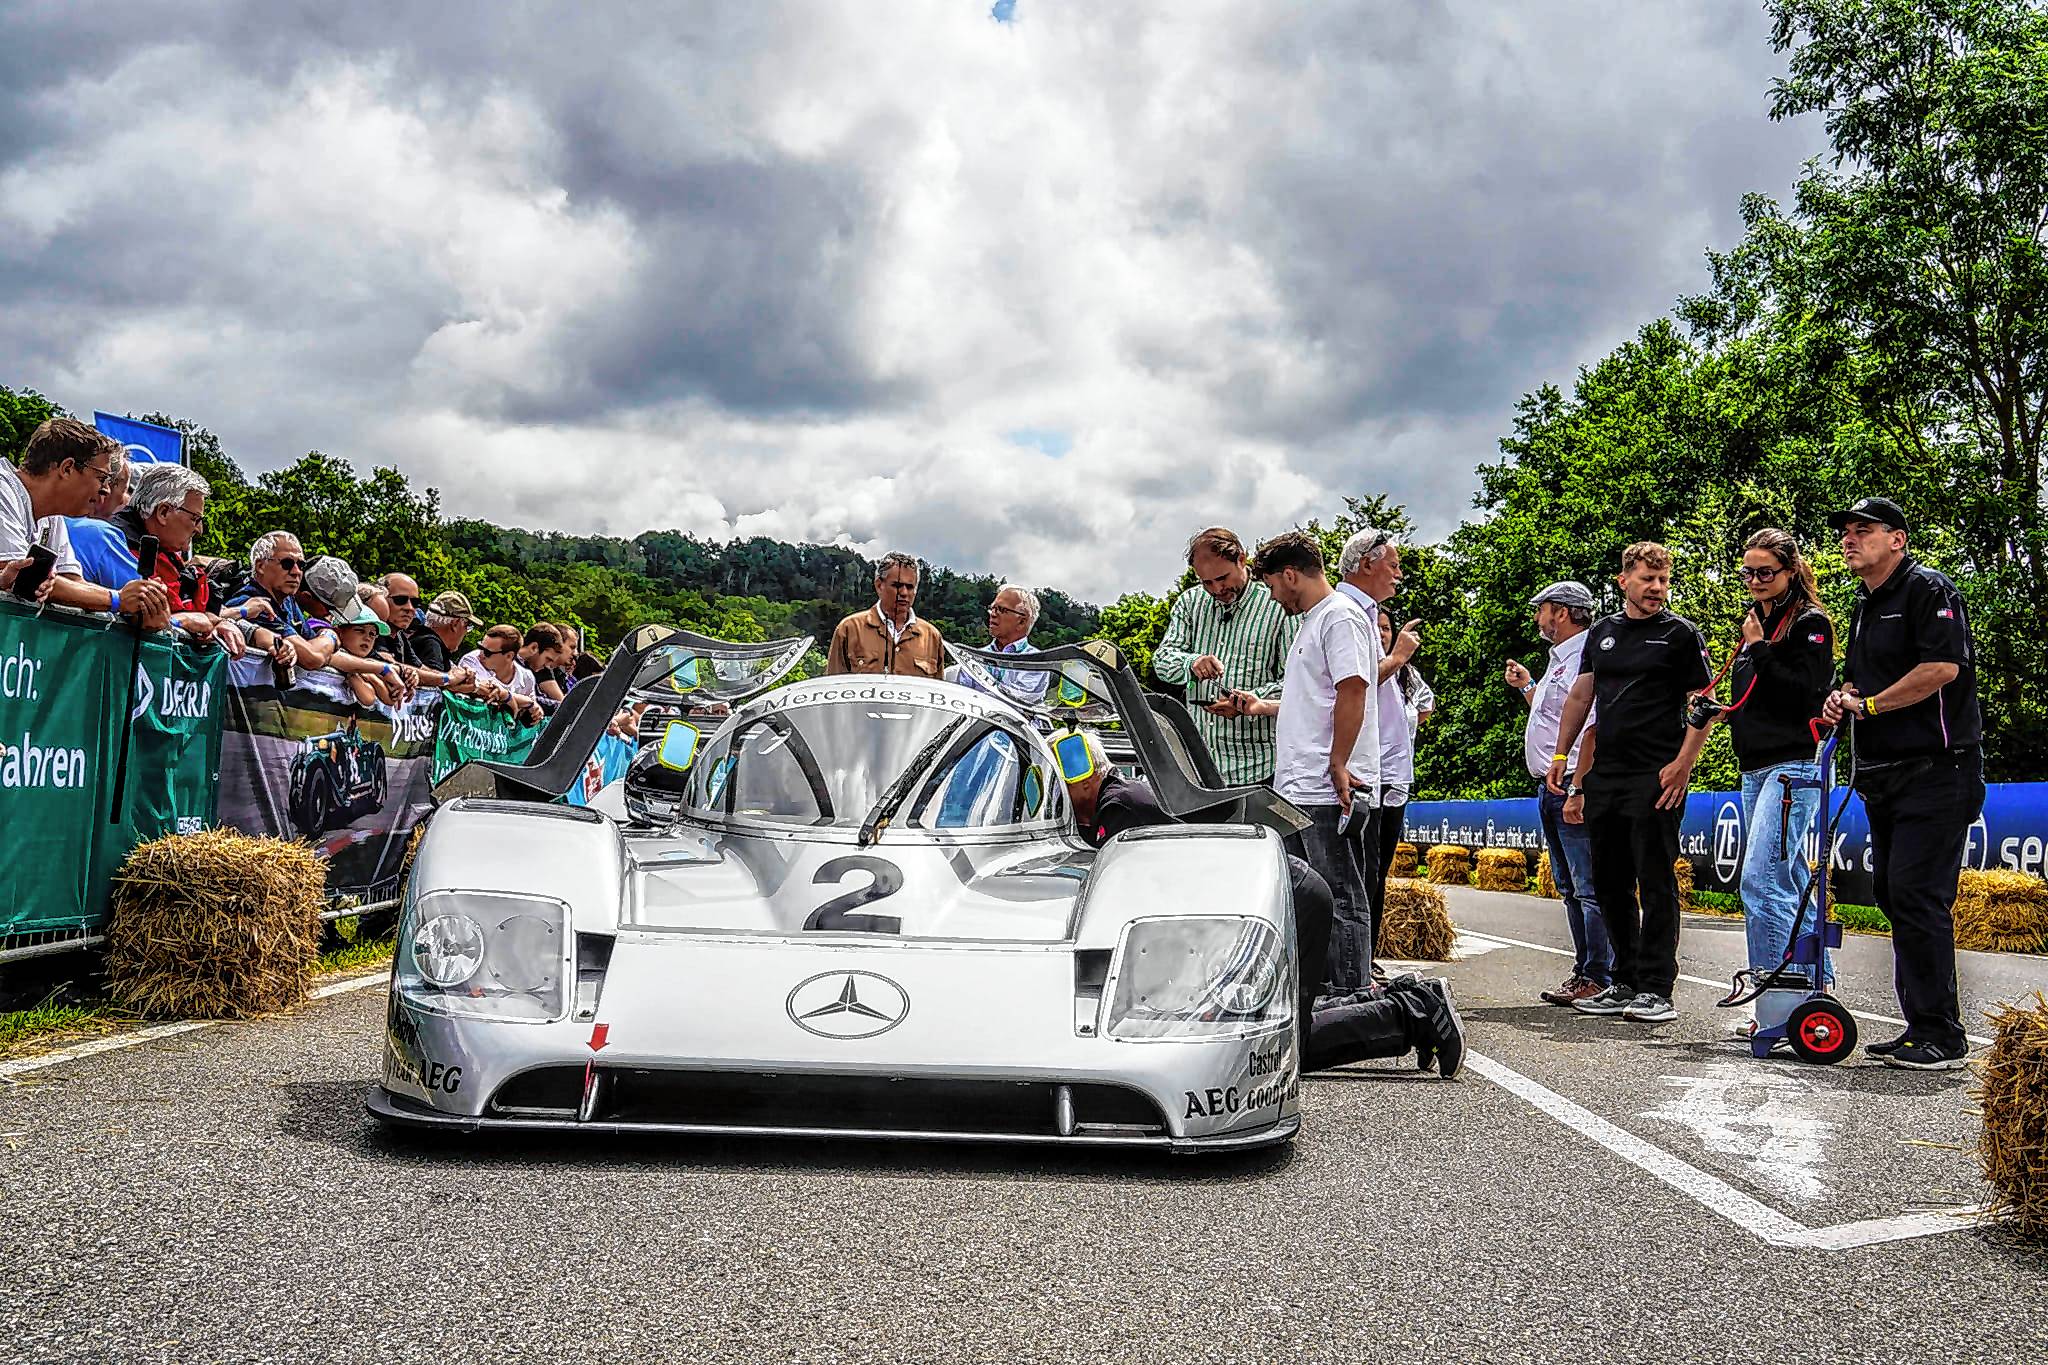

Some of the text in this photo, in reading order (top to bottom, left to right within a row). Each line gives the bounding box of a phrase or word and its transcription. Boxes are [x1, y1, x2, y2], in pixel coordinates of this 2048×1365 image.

[0, 642, 42, 701] ch:
[762, 687, 987, 717] Mercedes-Ben
[0, 732, 85, 788] ahren
[2001, 836, 2048, 878] se
[803, 855, 904, 935] 2
[1184, 1086, 1240, 1119] AEG
